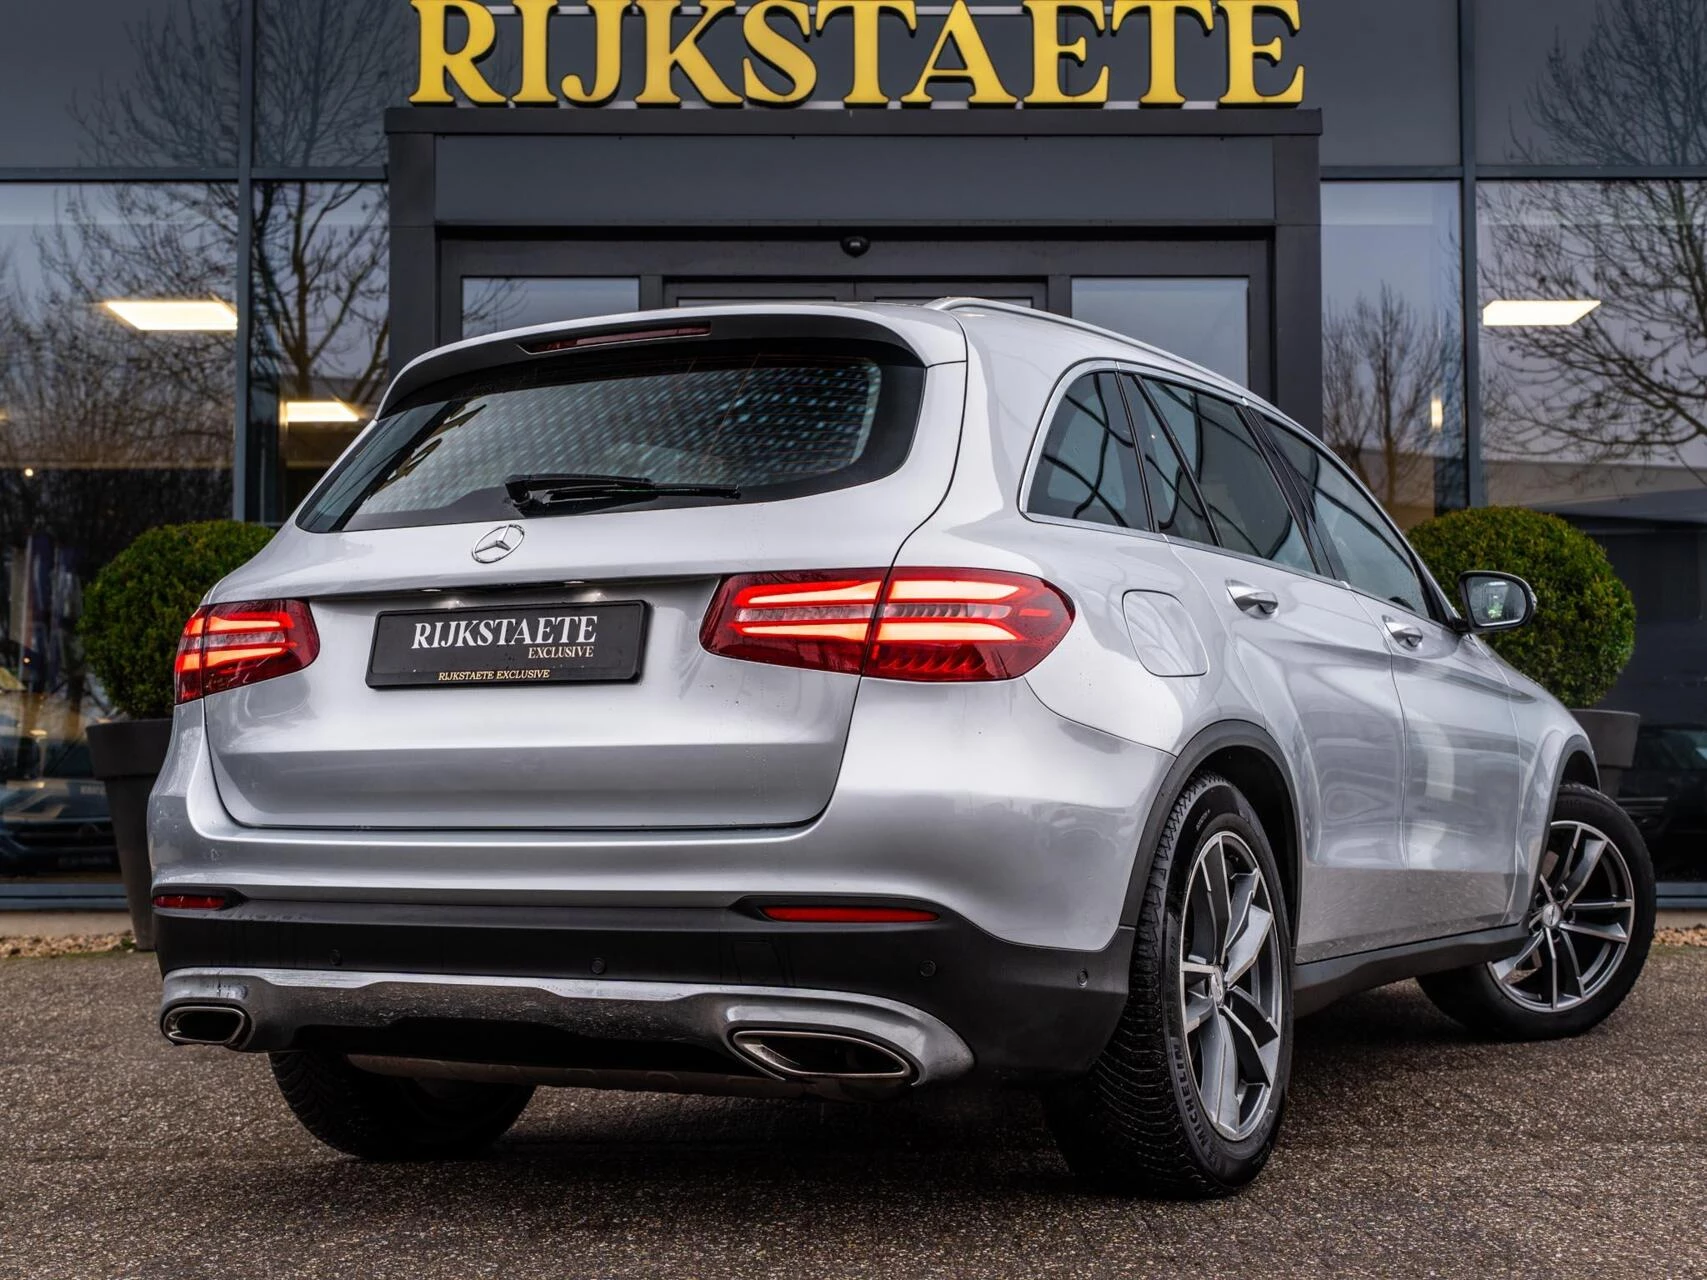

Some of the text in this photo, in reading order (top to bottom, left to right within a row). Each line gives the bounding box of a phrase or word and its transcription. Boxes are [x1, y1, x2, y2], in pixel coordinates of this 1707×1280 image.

[409, 0, 1305, 108] RIJKSTAETE
[411, 616, 598, 649] RIJKSTAETE
[528, 646, 594, 659] EXCLUSIVE
[438, 670, 550, 681] RIJKSTAETE EXCLUSIVE
[1173, 1043, 1209, 1147] MICHELIN
